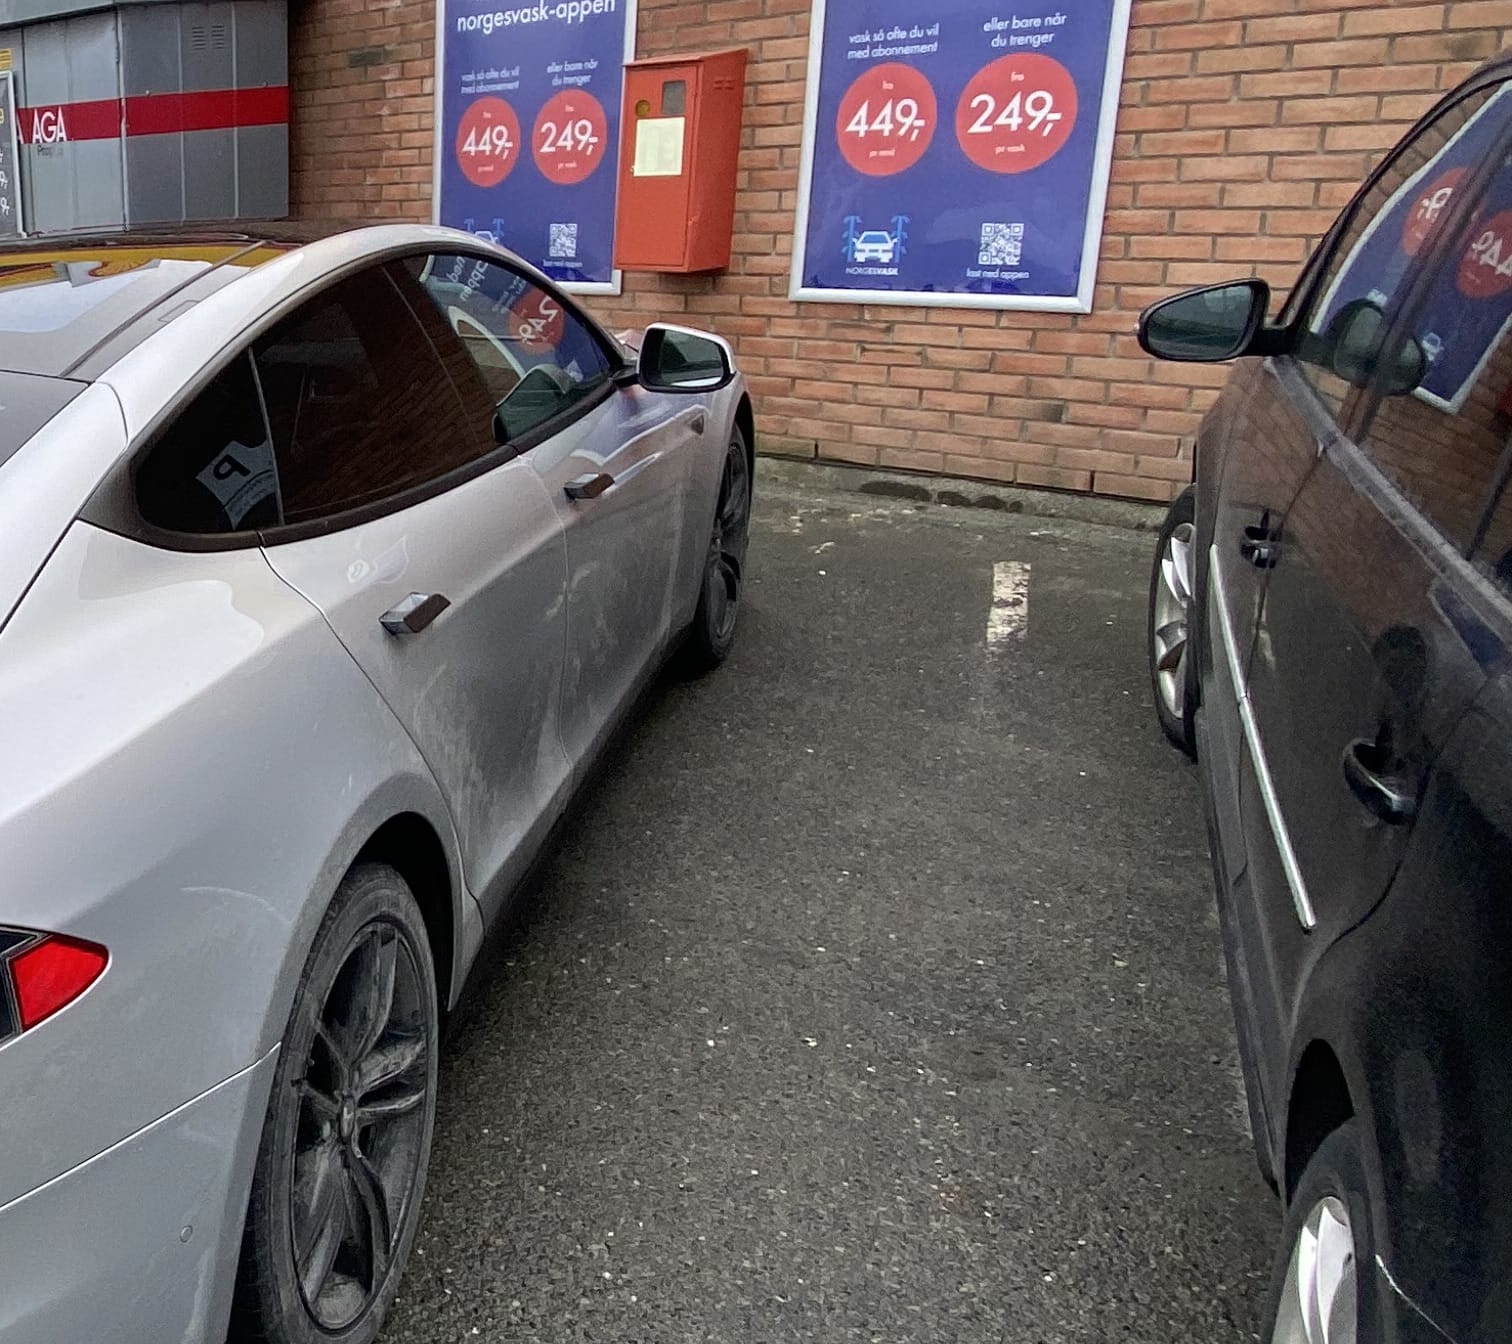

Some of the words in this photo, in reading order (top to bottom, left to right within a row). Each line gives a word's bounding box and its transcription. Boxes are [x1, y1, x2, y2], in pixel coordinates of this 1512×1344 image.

[849, 29, 871, 44] vask
[886, 25, 907, 40] ofte
[909, 24, 924, 38] du
[926, 22, 940, 36] vil
[983, 17, 1011, 33] eller
[1011, 16, 1042, 30] bare
[1044, 13, 1068, 27] når
[991, 34, 1007, 48] du
[1009, 31, 1055, 47] trenger
[848, 44, 870, 59] med
[871, 41, 938, 58] abonnement
[32, 106, 68, 145] AGA
[845, 98, 926, 142] 449,-
[967, 91, 1062, 137] 249,-
[462, 125, 513, 160] 449,-
[539, 119, 599, 156] 249,-
